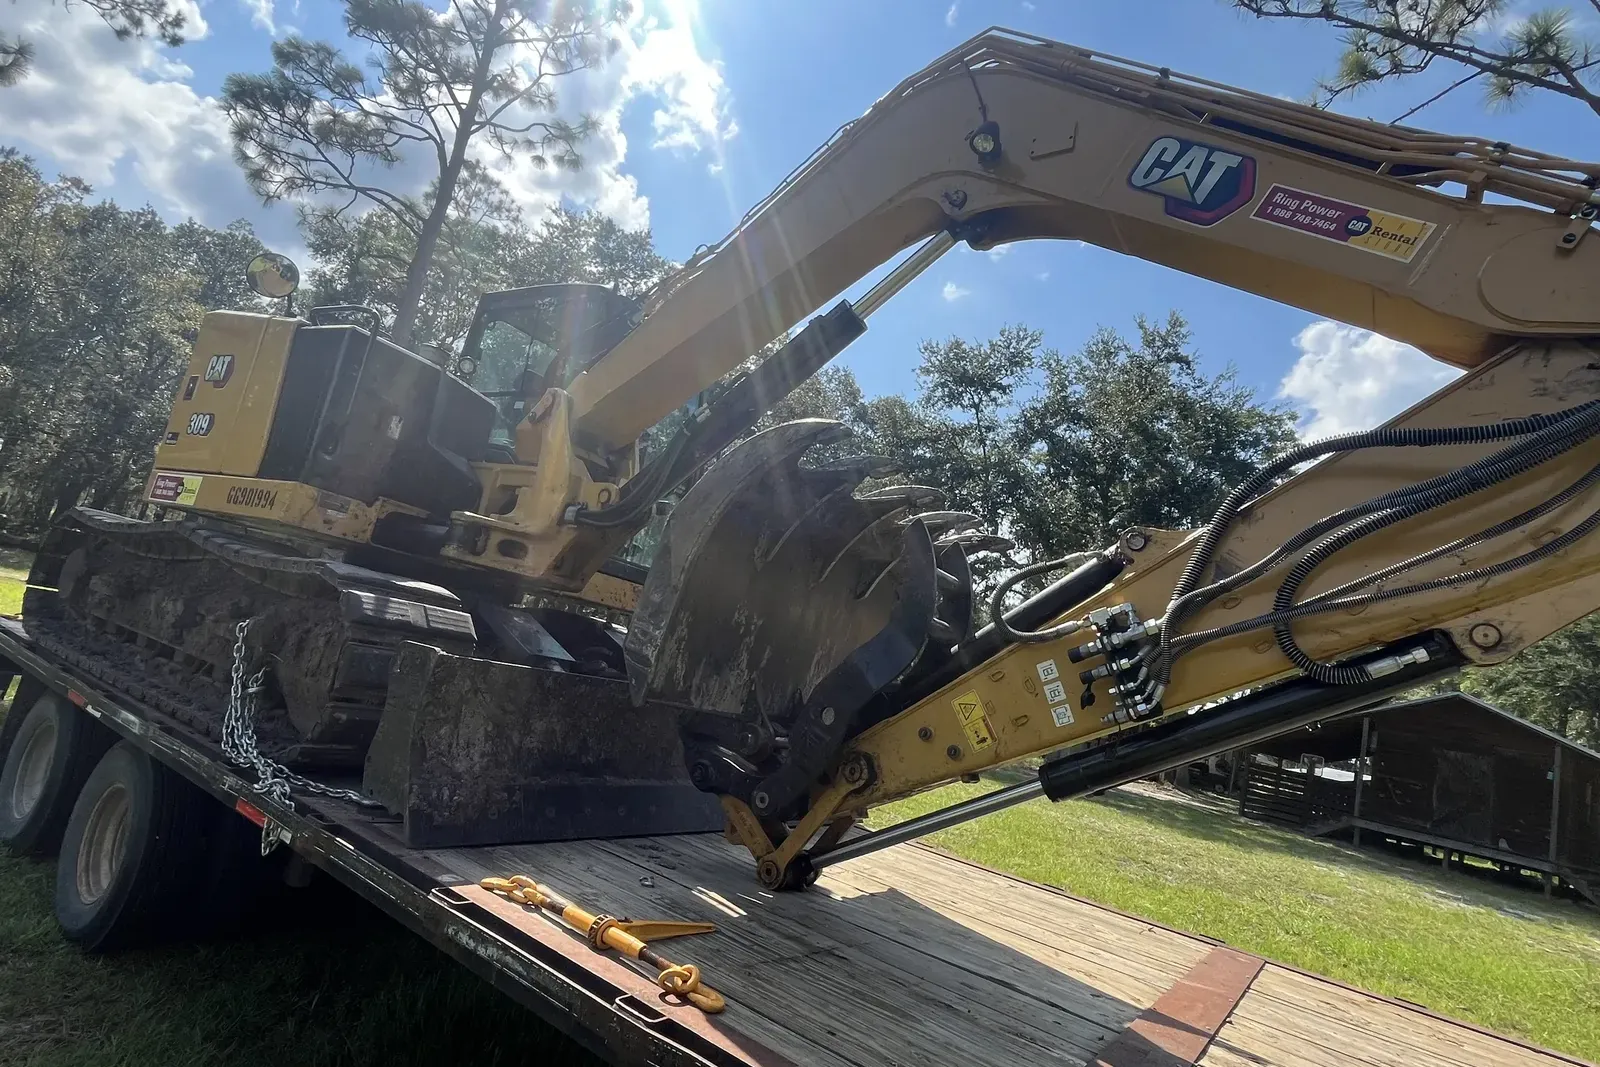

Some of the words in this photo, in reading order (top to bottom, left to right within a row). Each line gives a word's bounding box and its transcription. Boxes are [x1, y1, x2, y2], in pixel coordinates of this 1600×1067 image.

[1131, 137, 1243, 205] CAT
[1272, 192, 1300, 210] Ring
[1300, 200, 1342, 219] Power
[1266, 206, 1273, 214] 1
[1273, 208, 1293, 219] 888
[1293, 213, 1337, 231] 748-7464
[1348, 220, 1369, 232] CAT
[1370, 226, 1419, 246] Rental
[205, 356, 232, 381] CAT
[187, 413, 210, 435] 309
